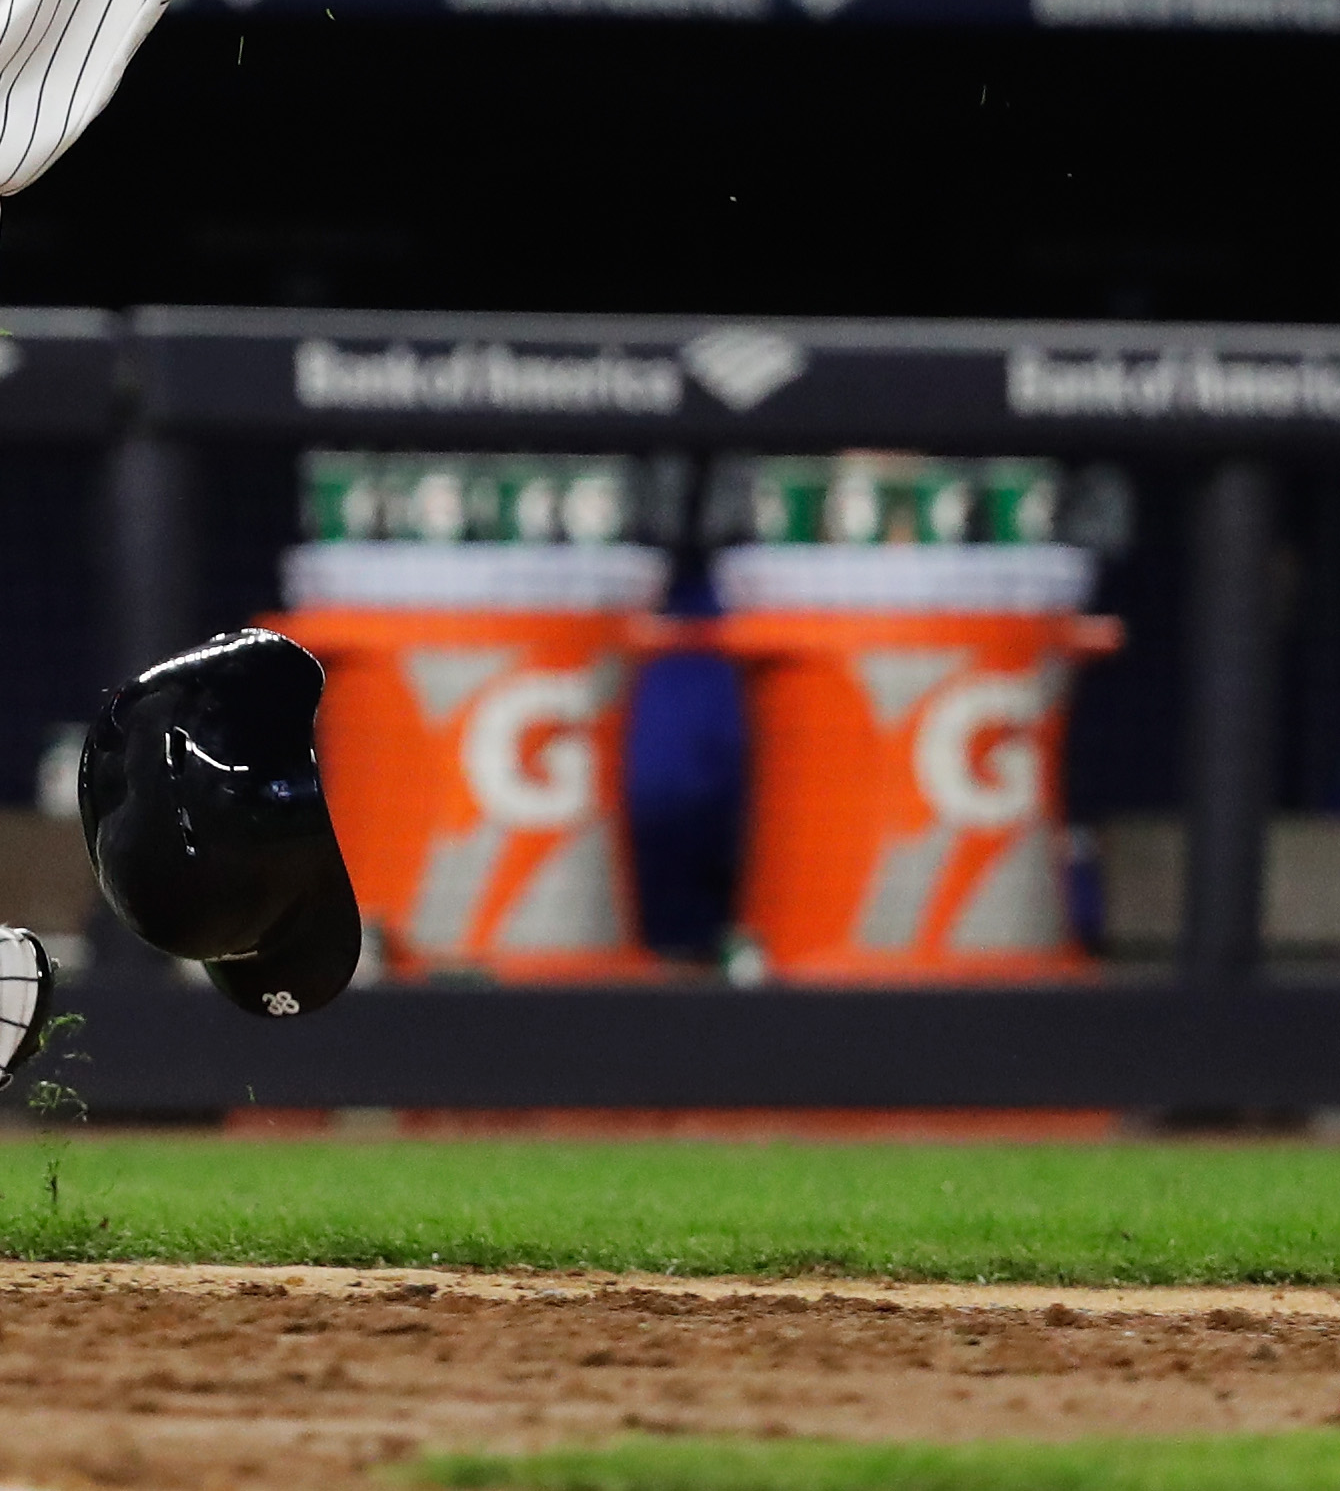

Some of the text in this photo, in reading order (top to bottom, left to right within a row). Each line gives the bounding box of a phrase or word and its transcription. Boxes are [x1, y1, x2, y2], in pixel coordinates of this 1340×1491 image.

[296, 340, 417, 411] Bank
[485, 341, 682, 416] America
[1006, 346, 1122, 417] Bank
[460, 669, 596, 831] G
[912, 672, 1044, 831] G
[262, 991, 300, 1016] 38
